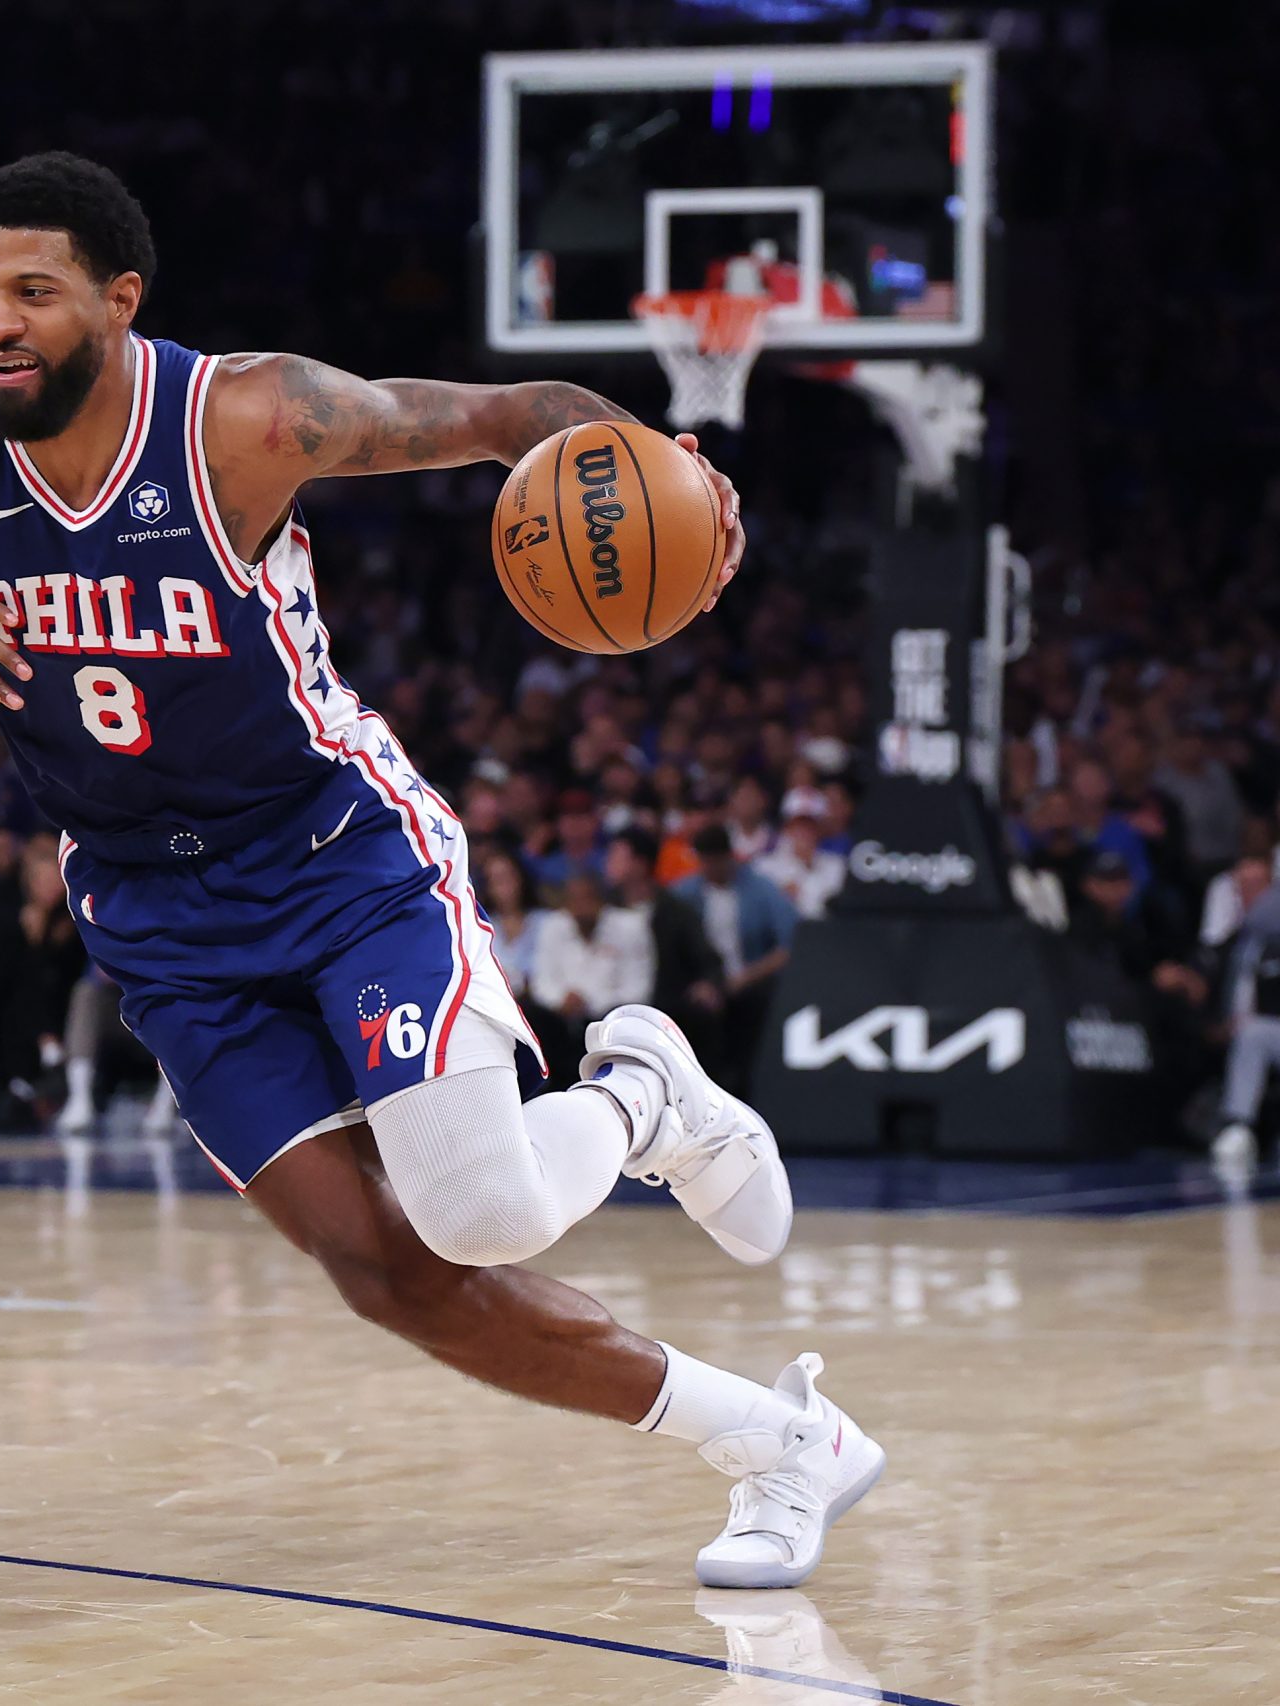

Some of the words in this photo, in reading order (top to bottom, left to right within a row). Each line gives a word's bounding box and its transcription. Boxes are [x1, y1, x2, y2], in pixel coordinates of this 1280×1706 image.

[117, 527, 191, 544] crypto.com
[574, 444, 626, 600] Wilson
[73, 665, 152, 756] 8
[849, 839, 976, 893] Google
[358, 1002, 426, 1071] 76
[783, 1004, 1025, 1074] KIA
